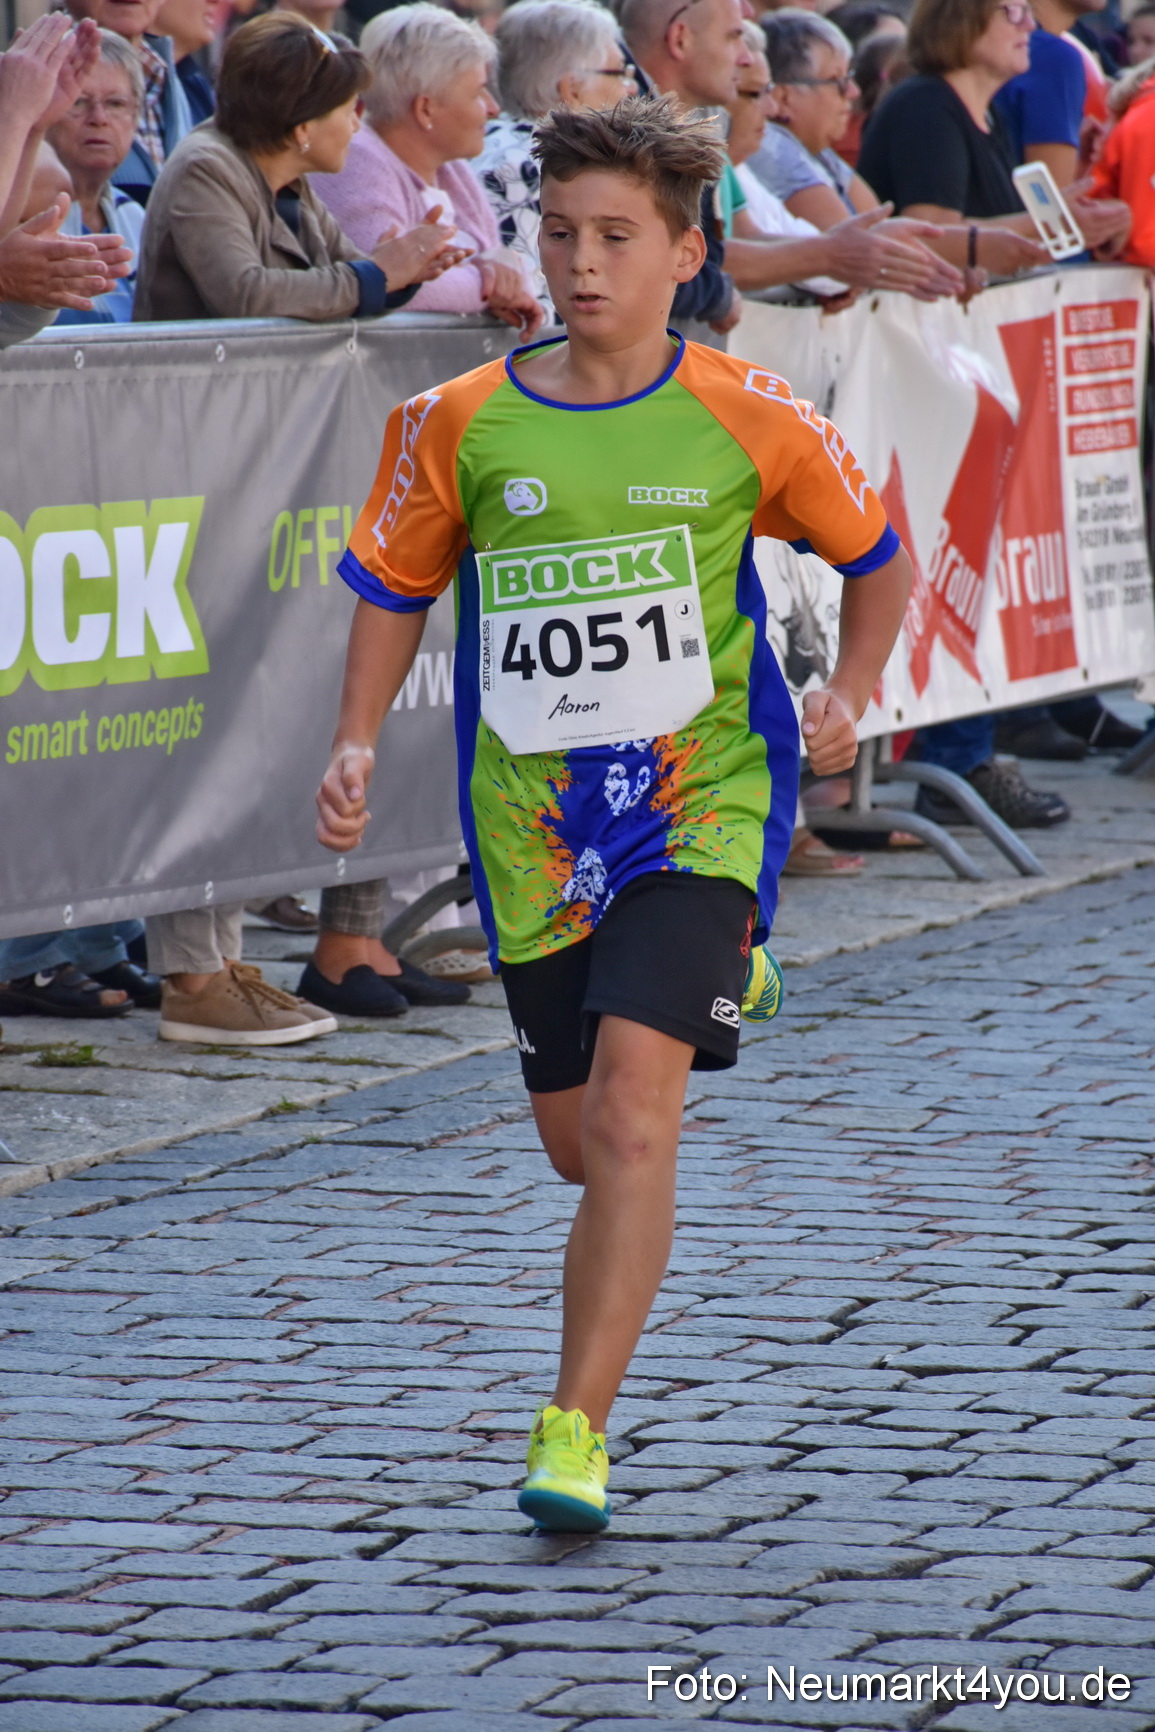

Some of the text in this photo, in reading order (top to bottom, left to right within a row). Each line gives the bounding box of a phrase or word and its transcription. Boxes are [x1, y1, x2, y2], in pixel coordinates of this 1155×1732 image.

[628, 486, 709, 507] BOCK
[268, 505, 352, 592] OFFI
[492, 540, 676, 605] BOCK
[680, 604, 689, 615] J
[501, 604, 671, 681] 4051
[5, 696, 204, 764] smart concepts
[548, 693, 600, 719] Aaron
